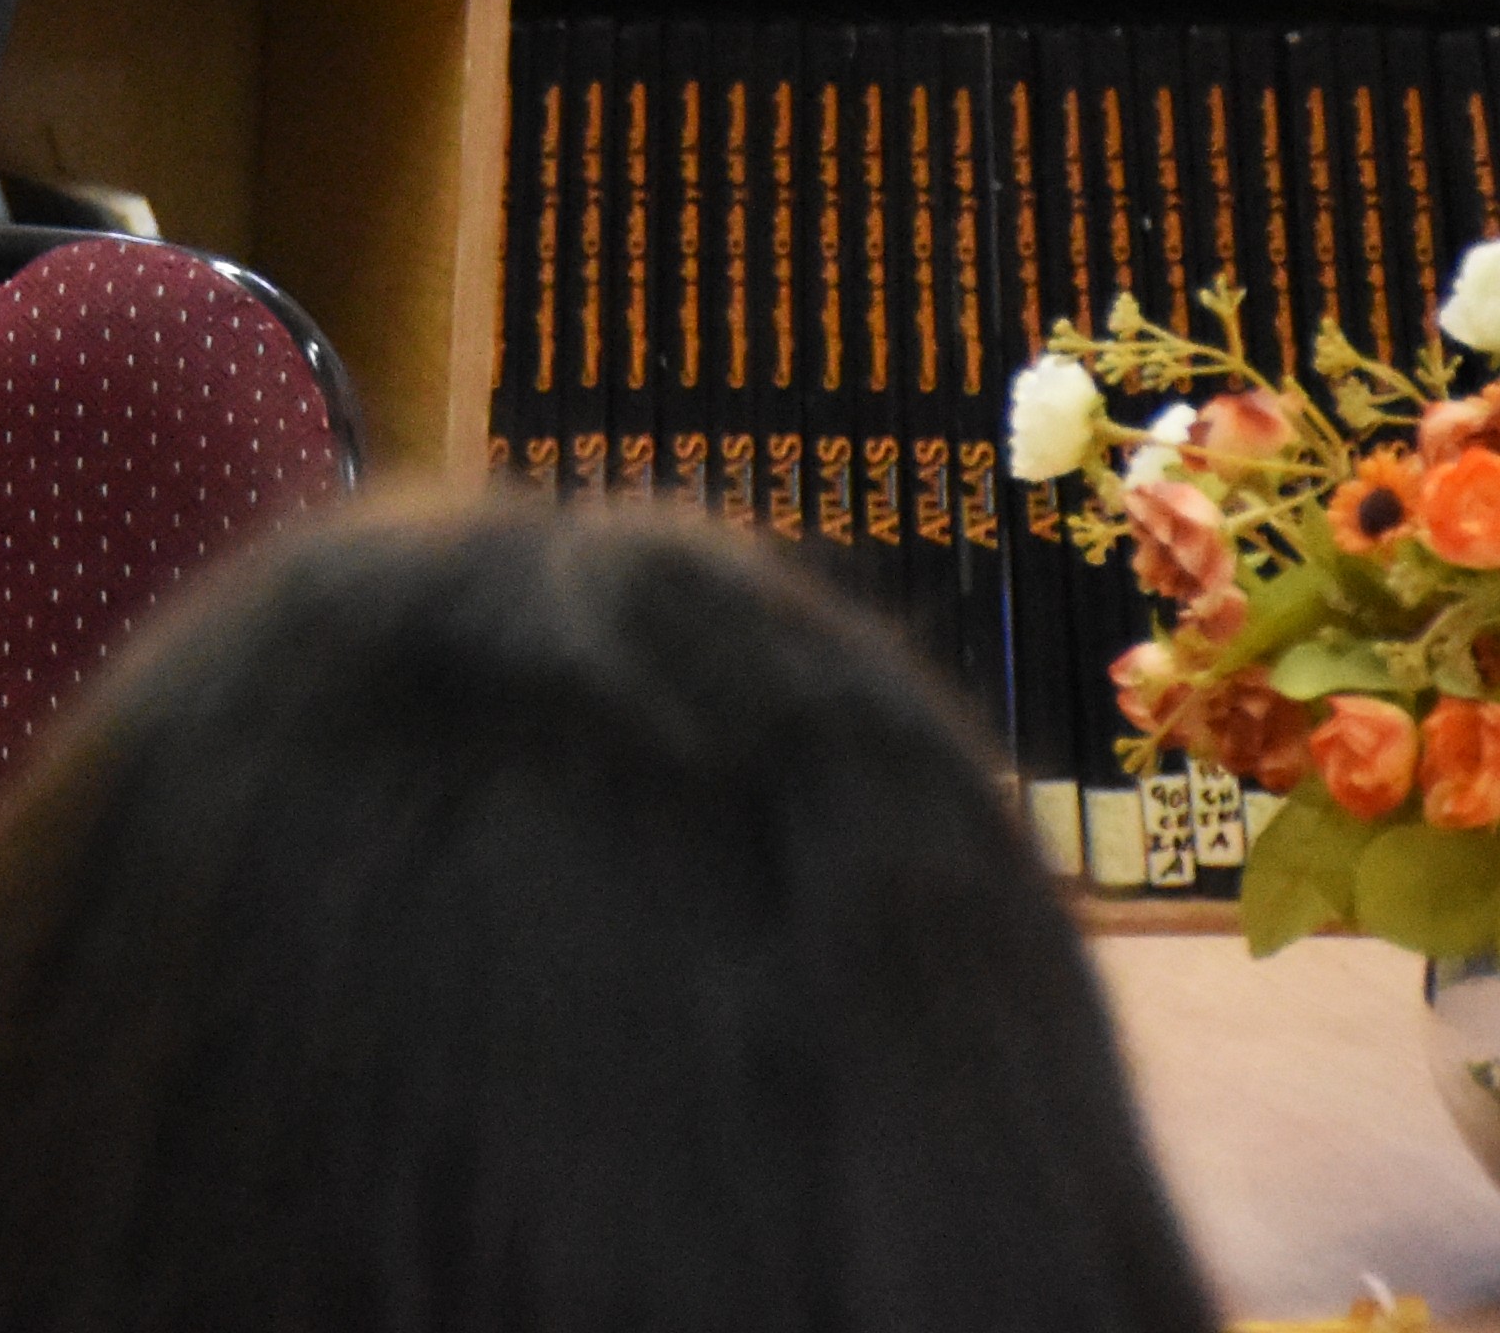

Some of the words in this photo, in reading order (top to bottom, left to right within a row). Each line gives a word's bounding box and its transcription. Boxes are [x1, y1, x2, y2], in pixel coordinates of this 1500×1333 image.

[769, 435, 800, 540] ATLAS
[818, 435, 852, 546] ATLAS
[866, 436, 900, 546] ATLAS
[915, 437, 951, 546] ATLAS
[960, 440, 997, 549] ATLAS
